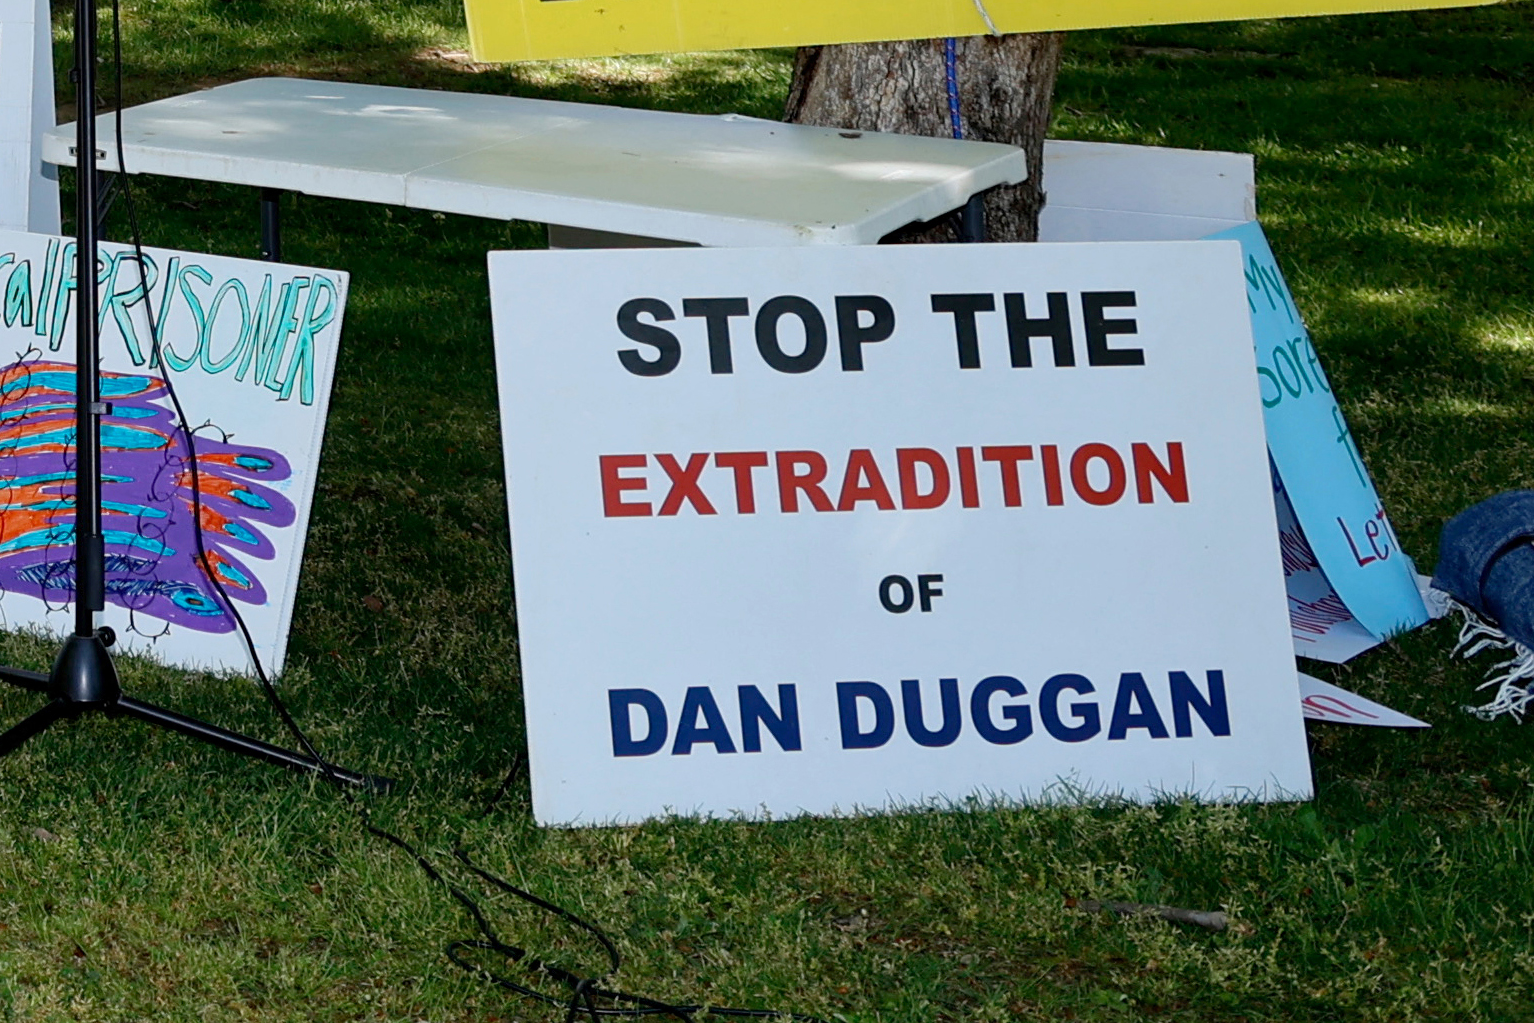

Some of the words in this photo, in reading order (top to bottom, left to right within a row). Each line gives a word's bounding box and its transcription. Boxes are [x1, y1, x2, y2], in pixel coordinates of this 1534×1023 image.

[616, 294, 896, 377] STOP
[930, 290, 1146, 369] THE
[598, 441, 1191, 518] EXTRADITION
[878, 573, 944, 614] OF
[607, 682, 803, 758] DAN
[835, 668, 1233, 751] DUGGAN
